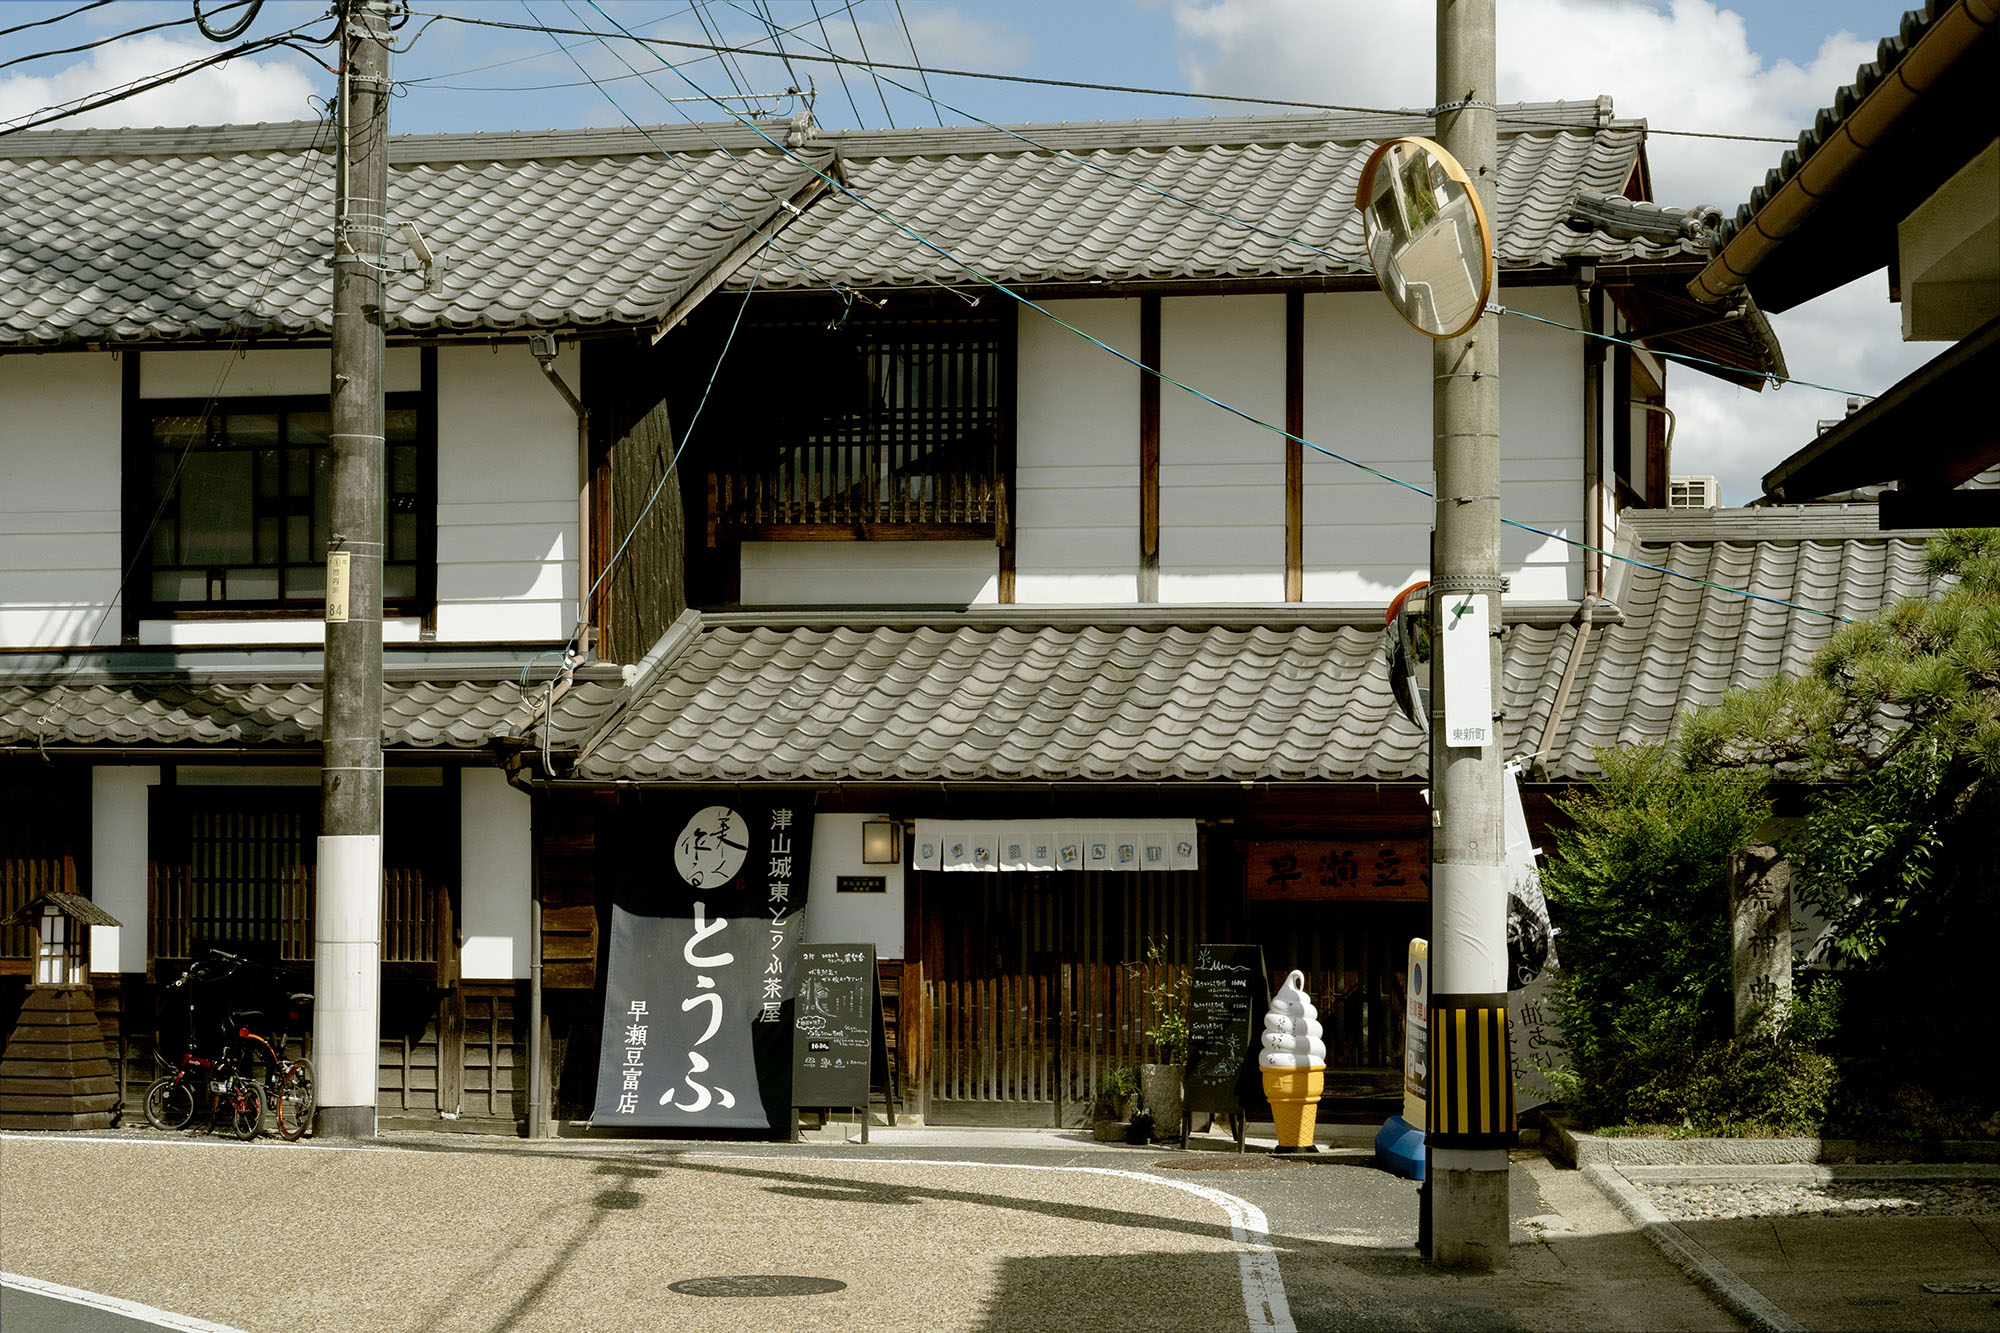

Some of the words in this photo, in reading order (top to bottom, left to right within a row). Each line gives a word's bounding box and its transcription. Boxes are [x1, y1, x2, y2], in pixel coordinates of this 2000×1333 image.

[329, 604, 342, 616] 84
[1453, 727, 1486, 741] 東新町
[1266, 848, 1429, 892] 早瀬豆
[760, 808, 793, 1023] 津山城東とうふ茶屋
[659, 901, 736, 1112] とうふ
[616, 1000, 649, 1114] 早瀬豆富店
